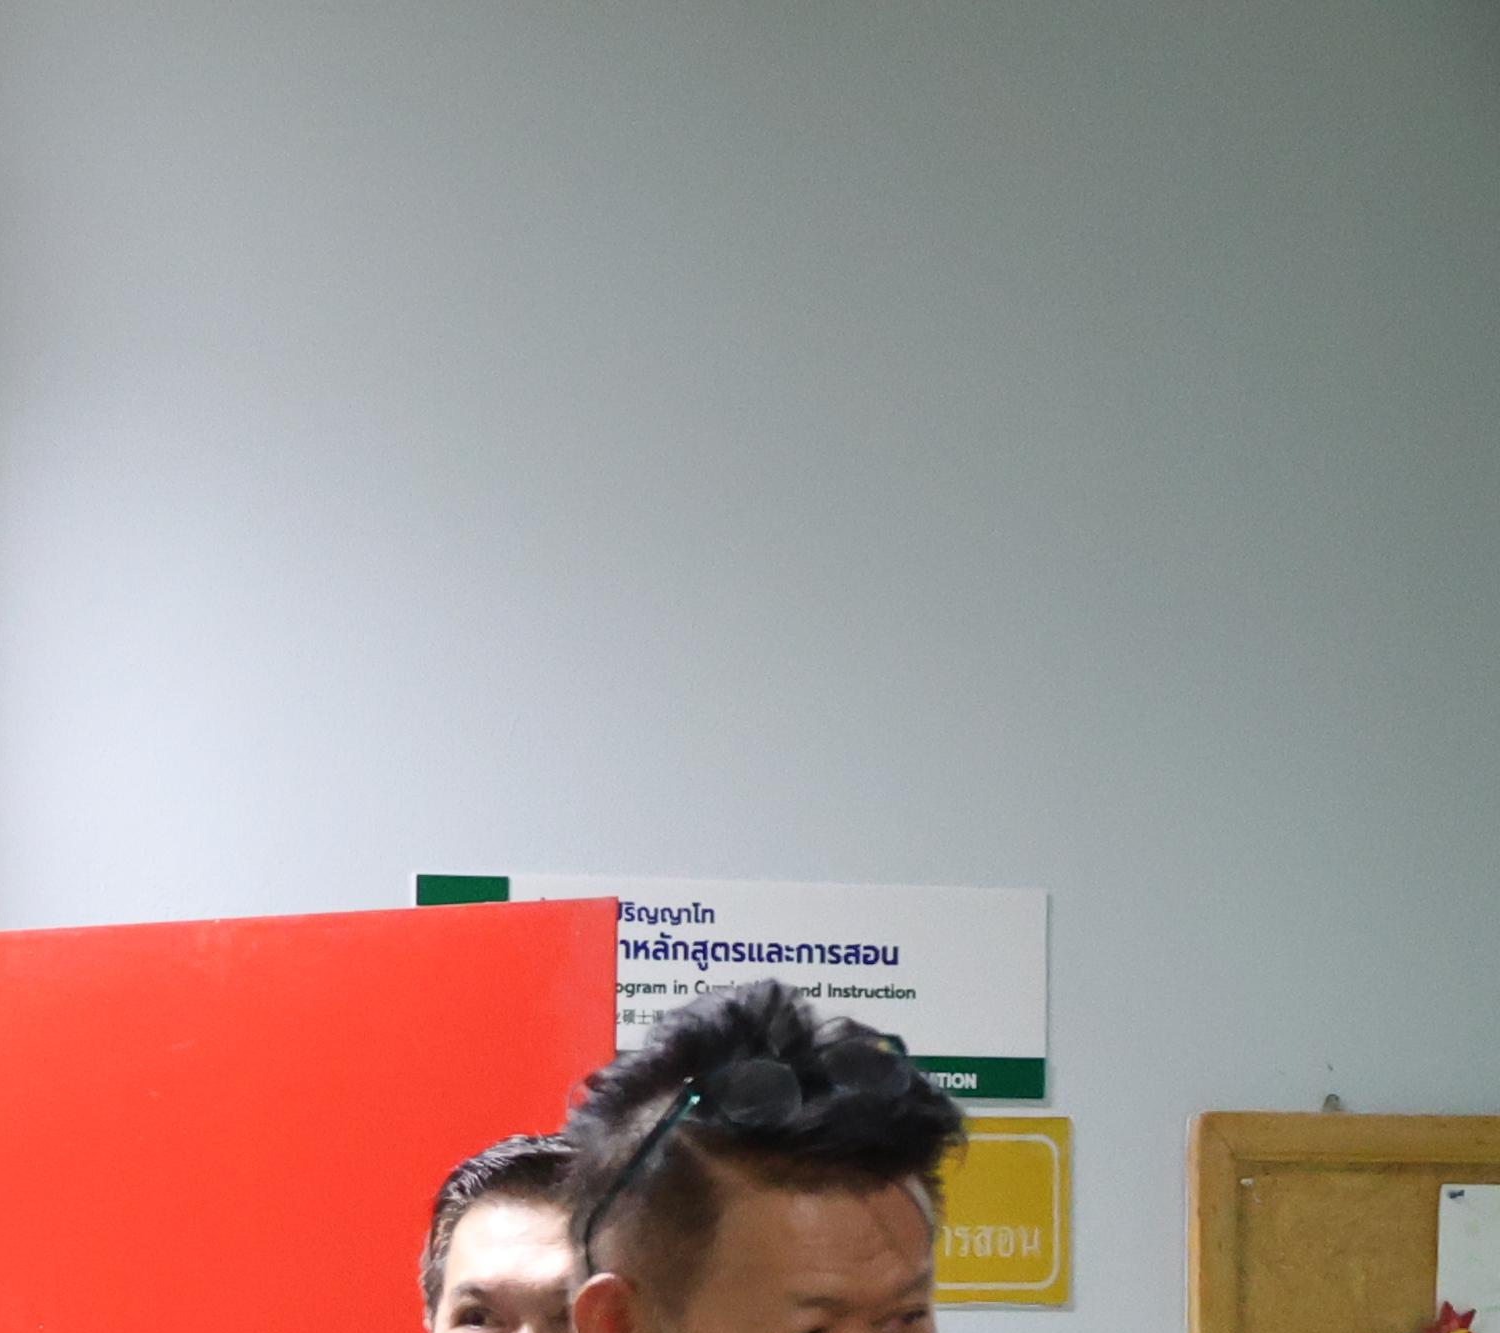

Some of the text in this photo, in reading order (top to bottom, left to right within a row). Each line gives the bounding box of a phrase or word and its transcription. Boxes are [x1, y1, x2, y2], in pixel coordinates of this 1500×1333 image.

[619, 932, 899, 971] าหลักสูตรและการสอน
[616, 982, 667, 998] ogram
[673, 980, 688, 995] in
[800, 983, 821, 998] nd
[828, 984, 916, 1000] Instruction
[941, 1225, 1042, 1258] ารสอน
